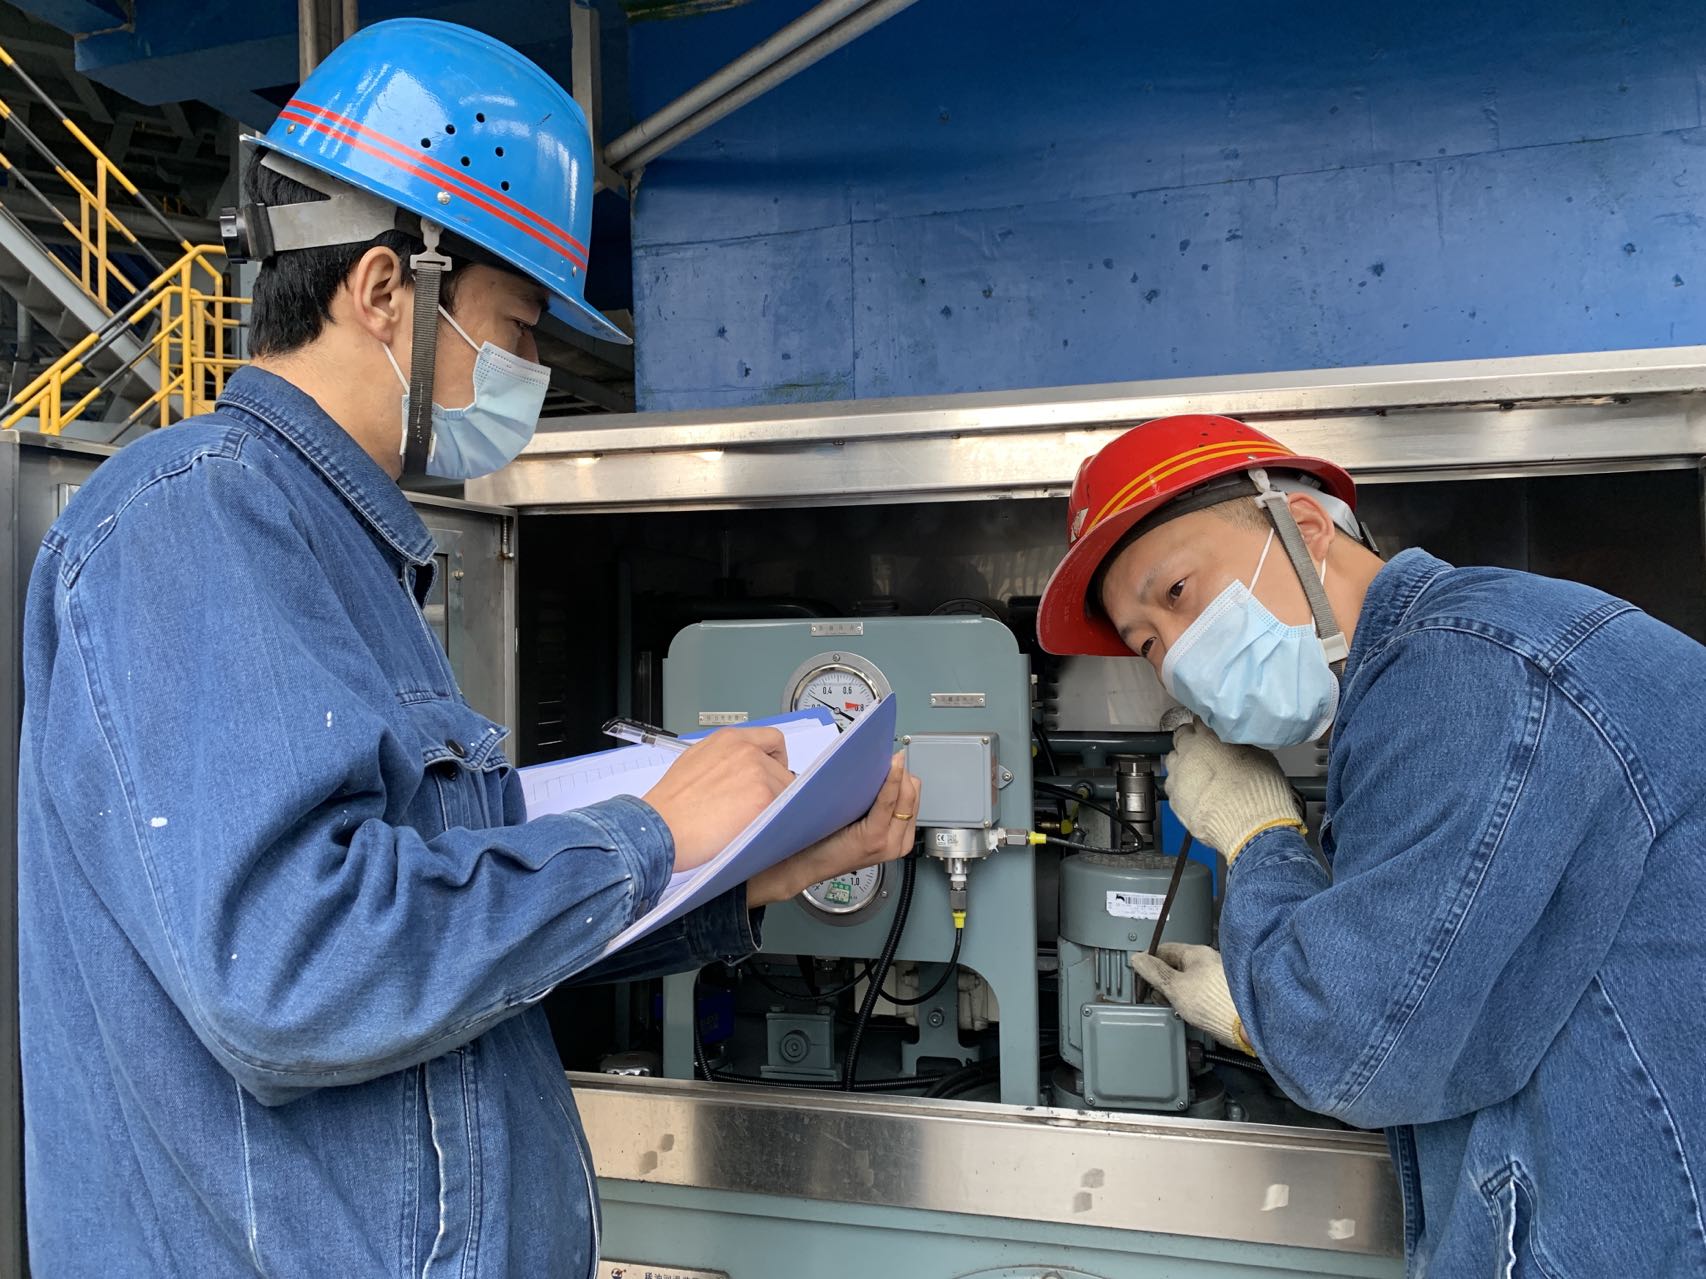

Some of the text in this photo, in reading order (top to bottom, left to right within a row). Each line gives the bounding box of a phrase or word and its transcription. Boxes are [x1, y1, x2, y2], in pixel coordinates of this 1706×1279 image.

[822, 686, 832, 694] 0.4
[842, 686, 852, 694] 0.6
[854, 704, 864, 712] 0.8
[850, 878, 860, 886] 1.0
